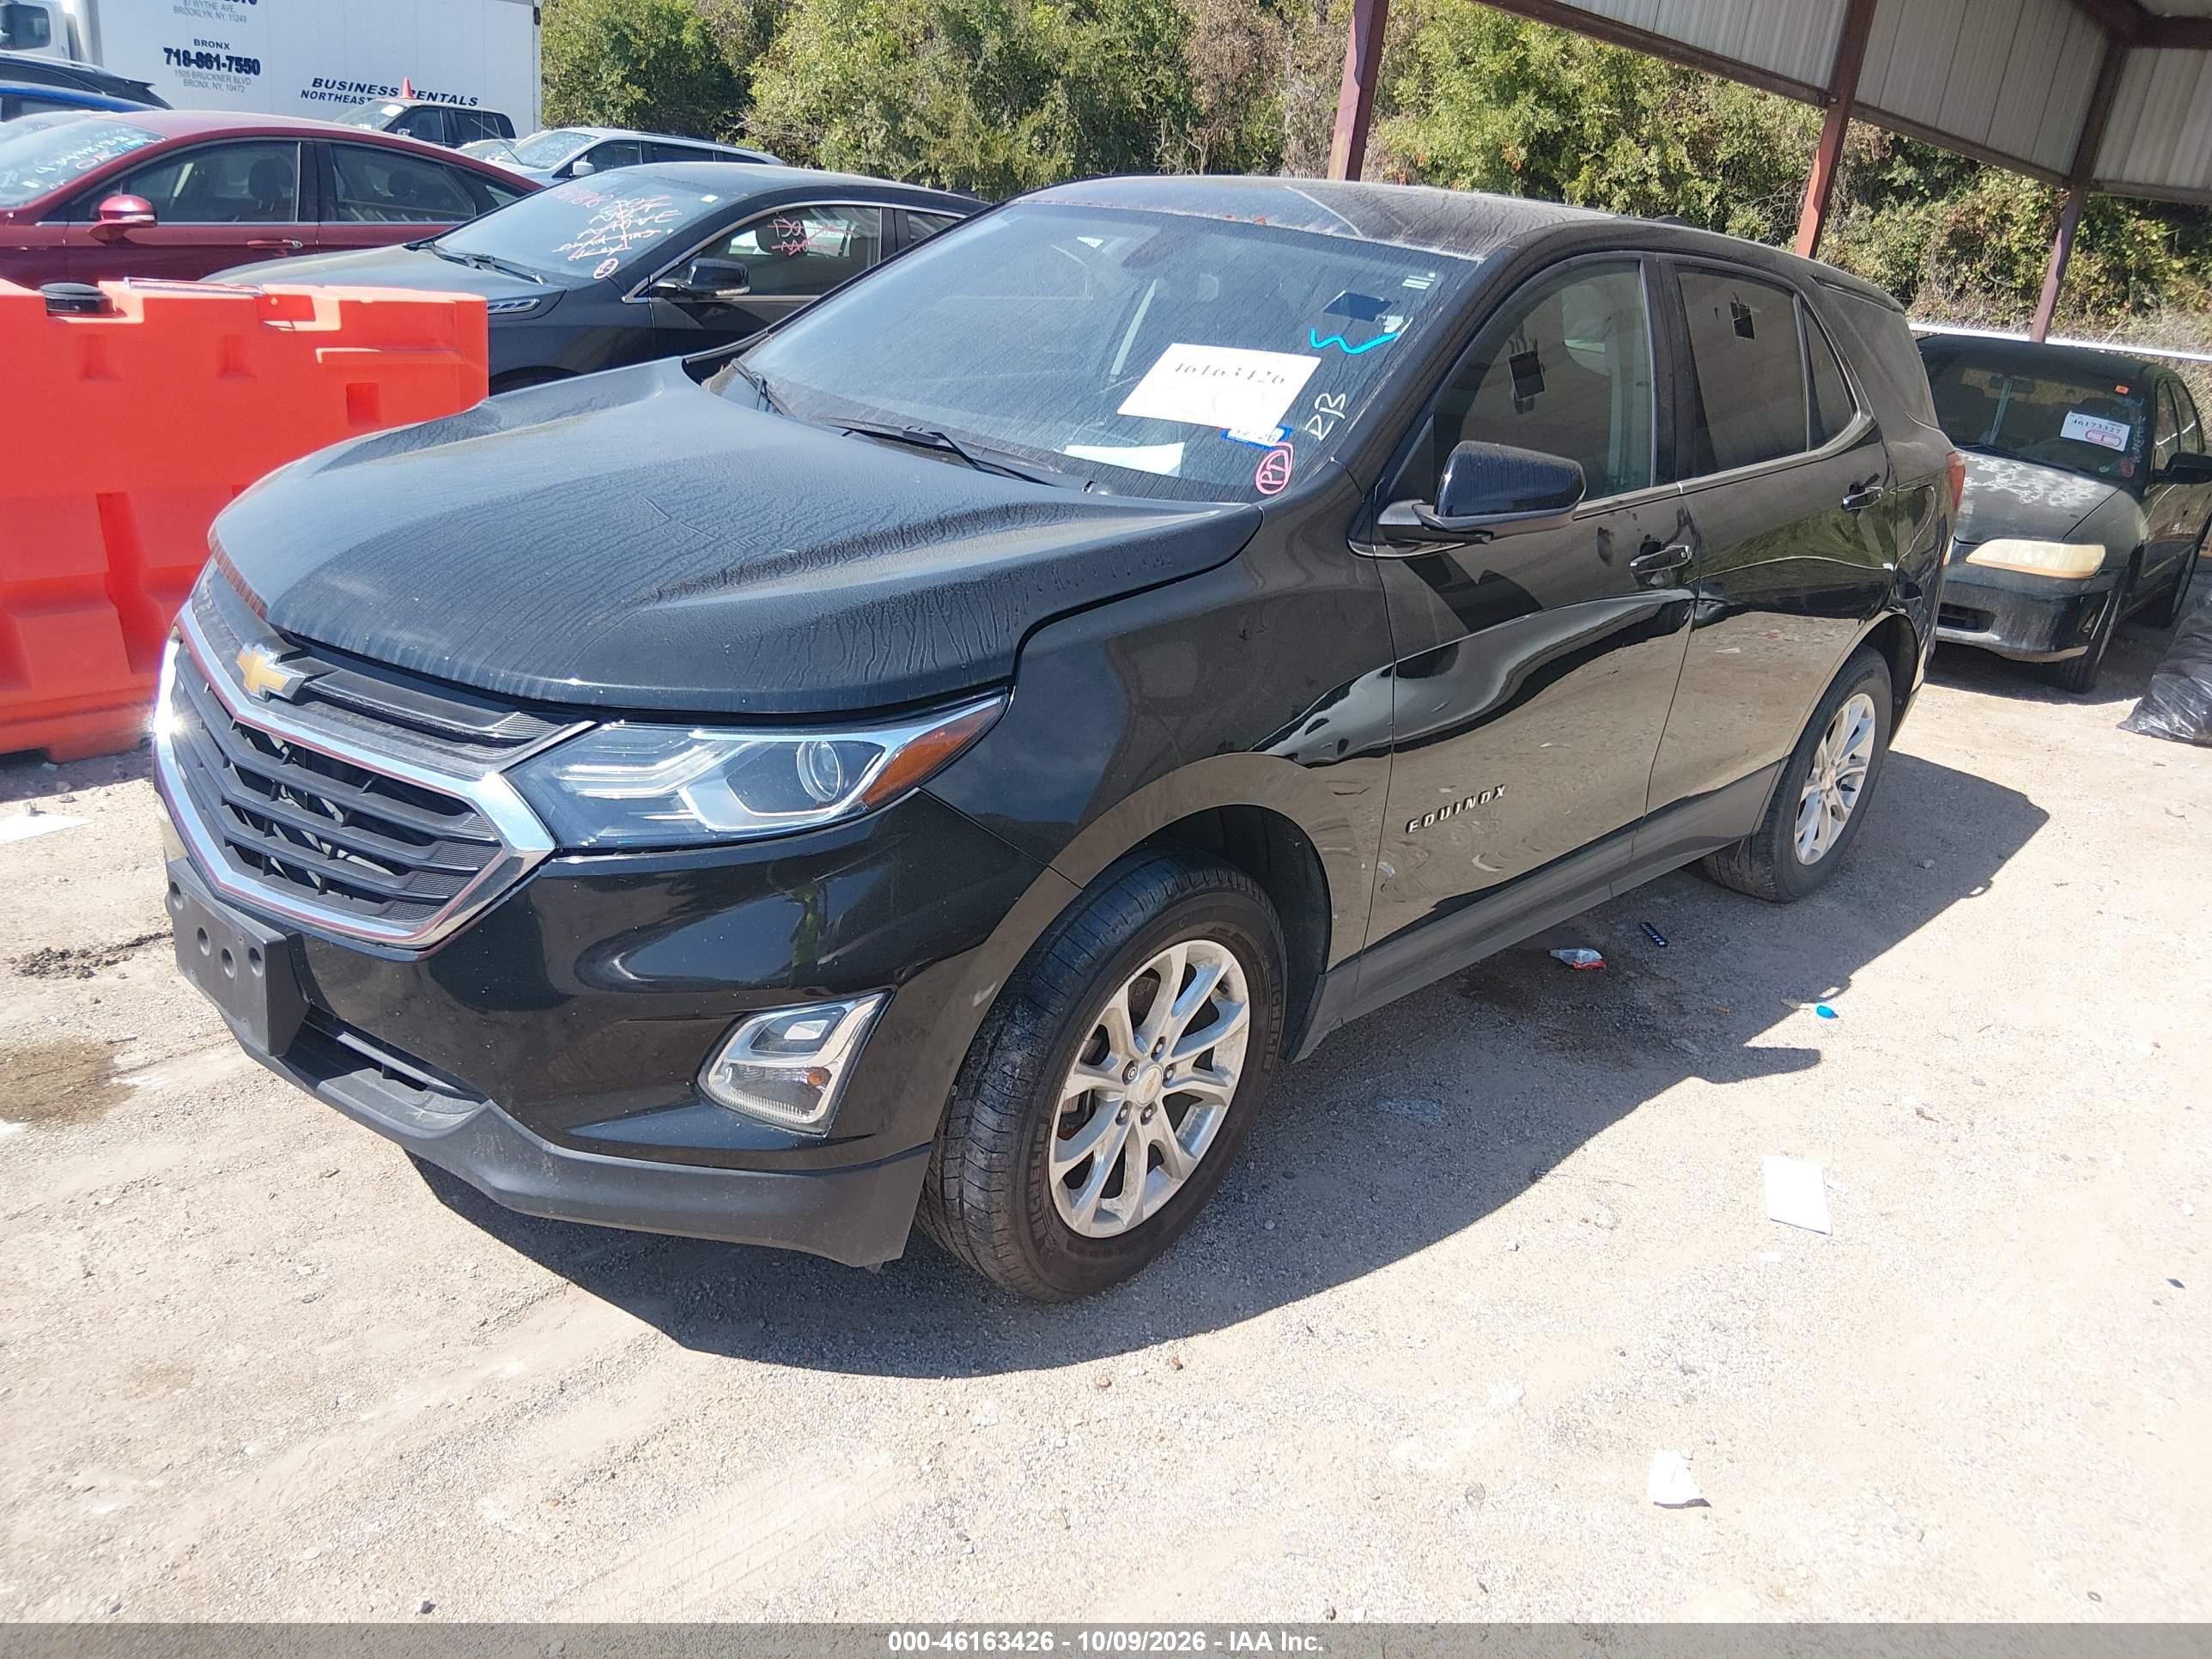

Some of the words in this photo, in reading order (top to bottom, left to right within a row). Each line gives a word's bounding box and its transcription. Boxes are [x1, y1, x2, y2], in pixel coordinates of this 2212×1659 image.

[193, 39, 231, 51] BRONX
[163, 46, 261, 76] 718-861-7550
[191, 70, 232, 83] BRUCKNER
[311, 77, 399, 97] BUSINESS
[1406, 783, 1506, 835] EQUINOX
